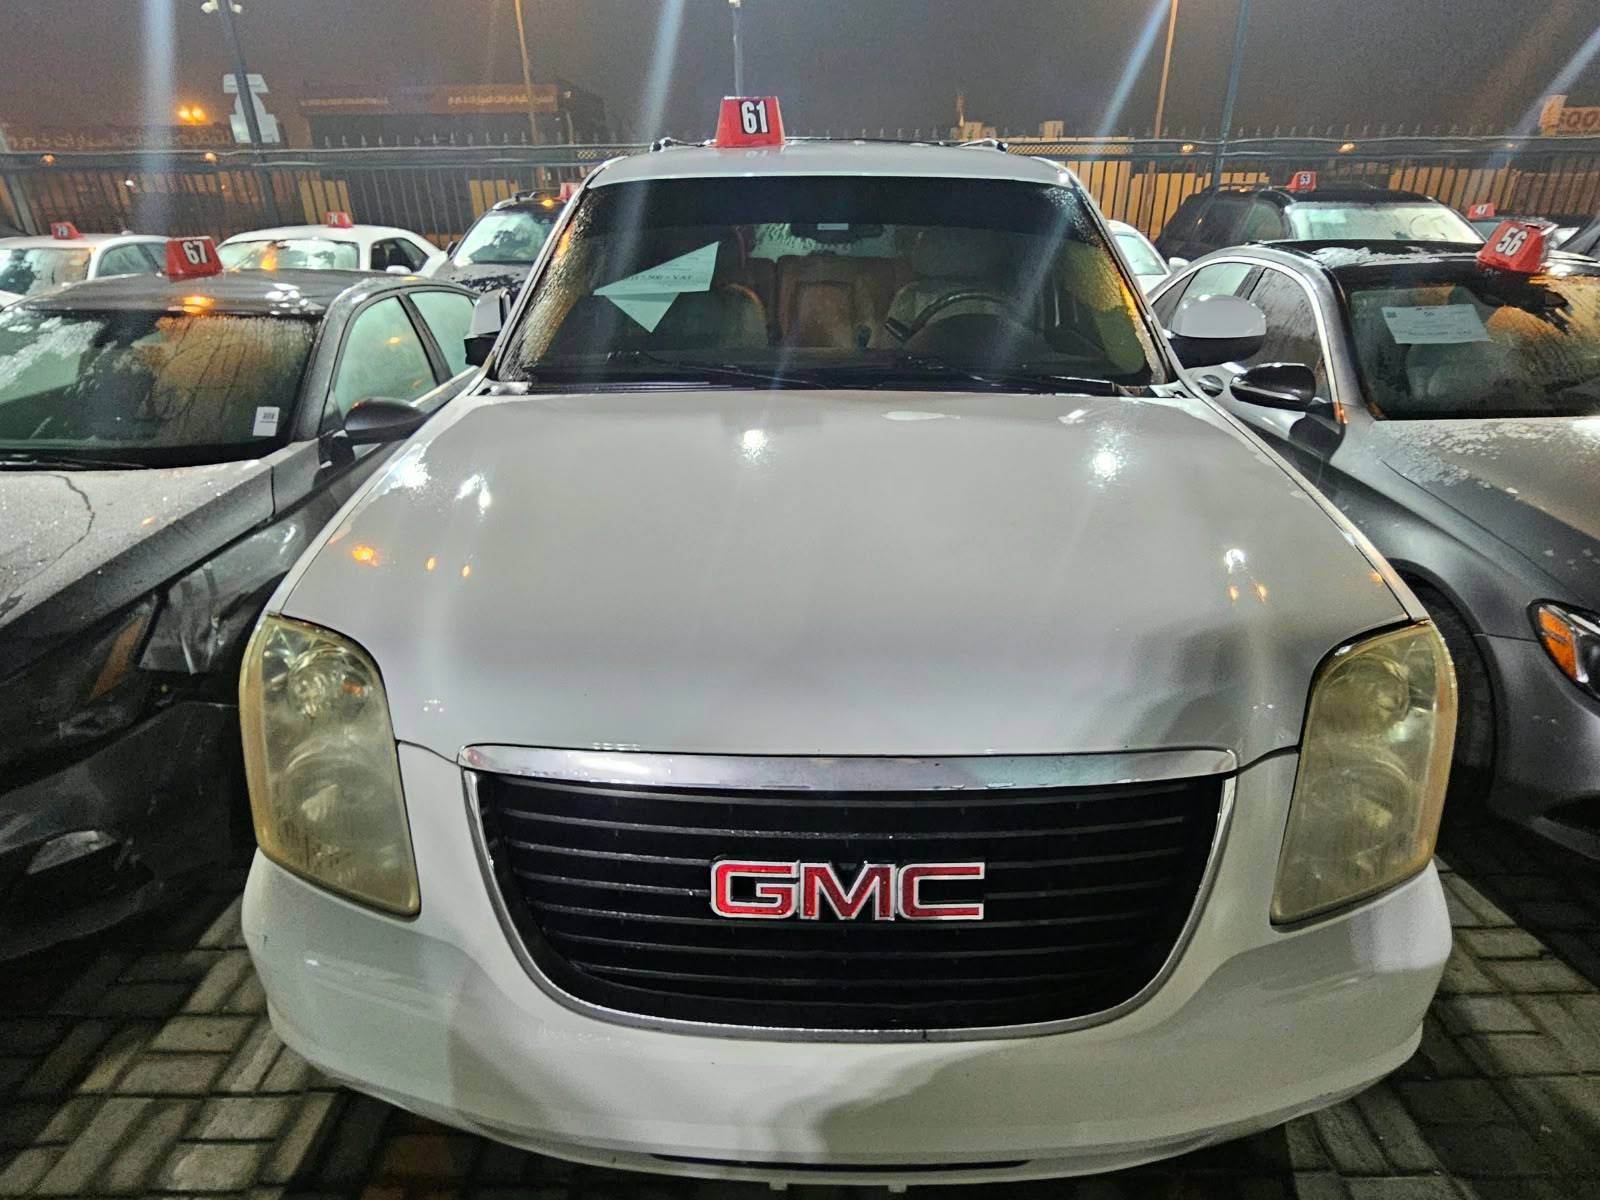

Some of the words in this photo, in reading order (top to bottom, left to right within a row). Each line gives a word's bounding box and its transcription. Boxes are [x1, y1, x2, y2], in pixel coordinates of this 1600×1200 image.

[741, 100, 769, 134] 61
[182, 240, 207, 265] 67
[1495, 227, 1528, 256] 56
[710, 859, 985, 921] GMC
